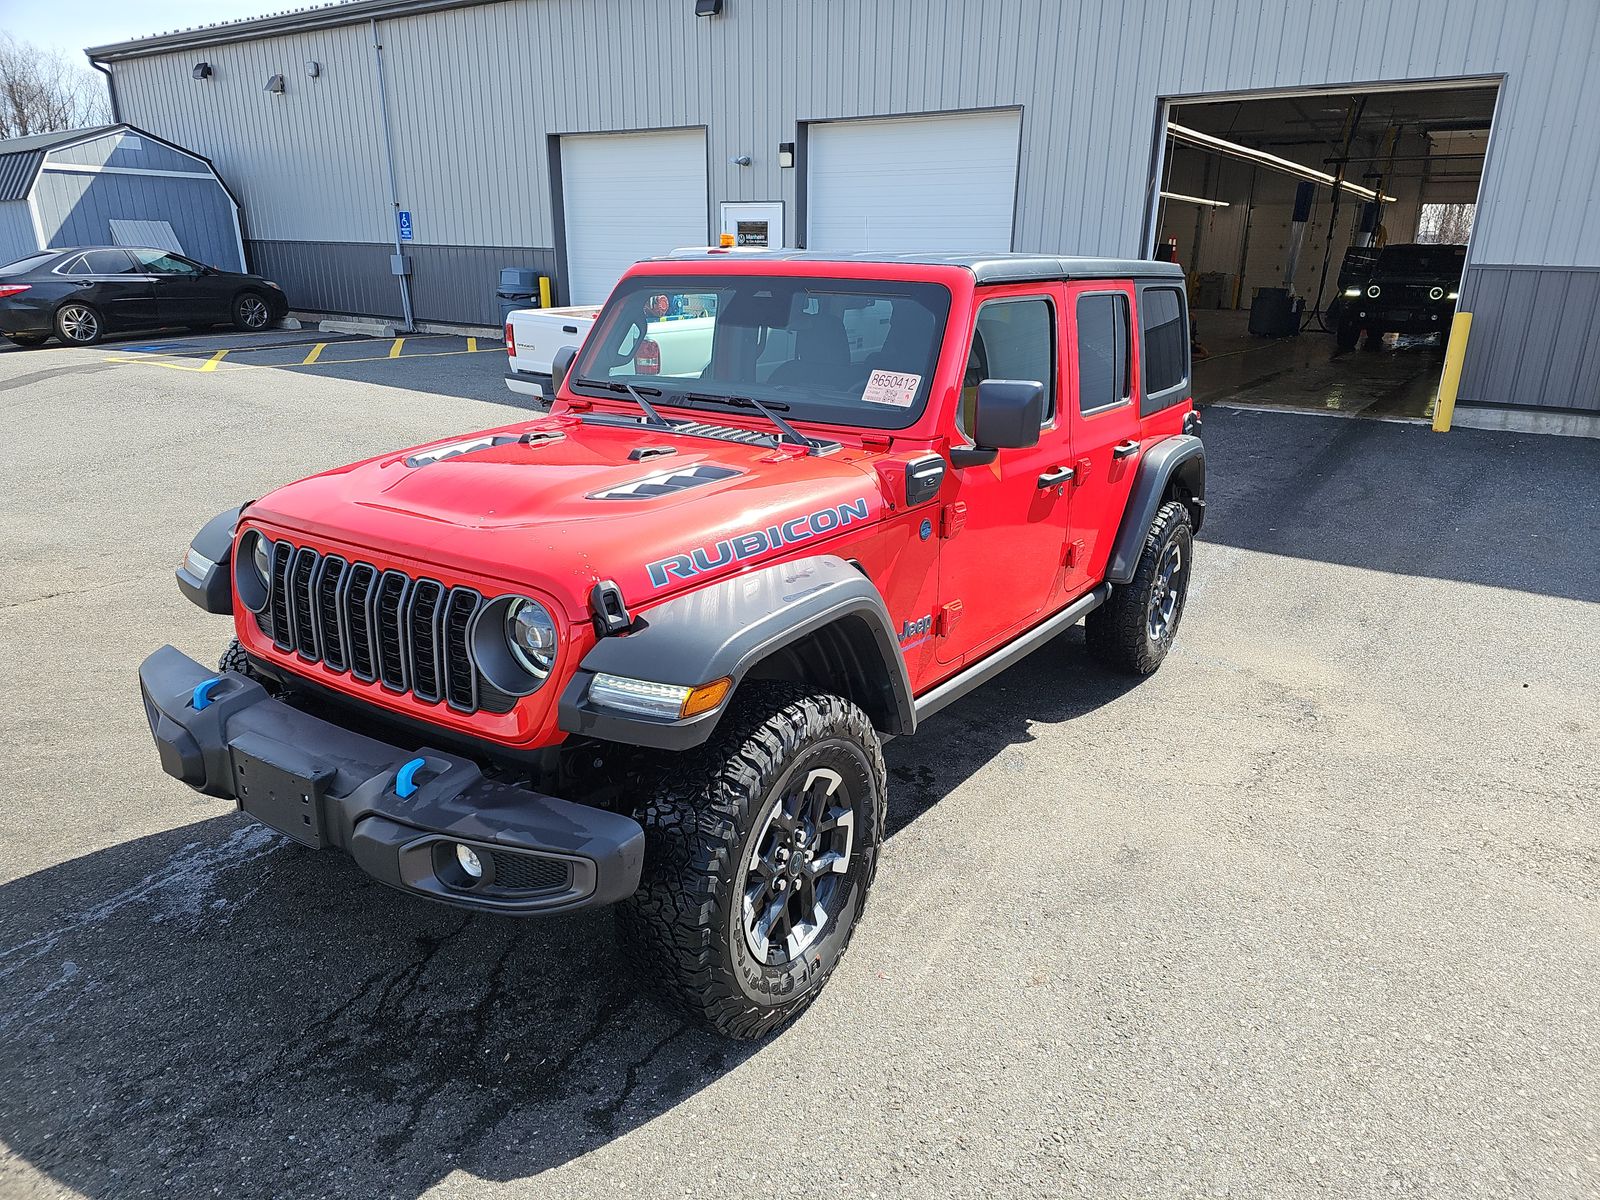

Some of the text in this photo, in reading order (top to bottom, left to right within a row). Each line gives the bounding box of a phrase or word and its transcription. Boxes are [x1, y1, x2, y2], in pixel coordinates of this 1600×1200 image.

[871, 373, 917, 391] 8650412
[646, 498, 868, 588] RUBICON
[897, 614, 932, 641] Jeep
